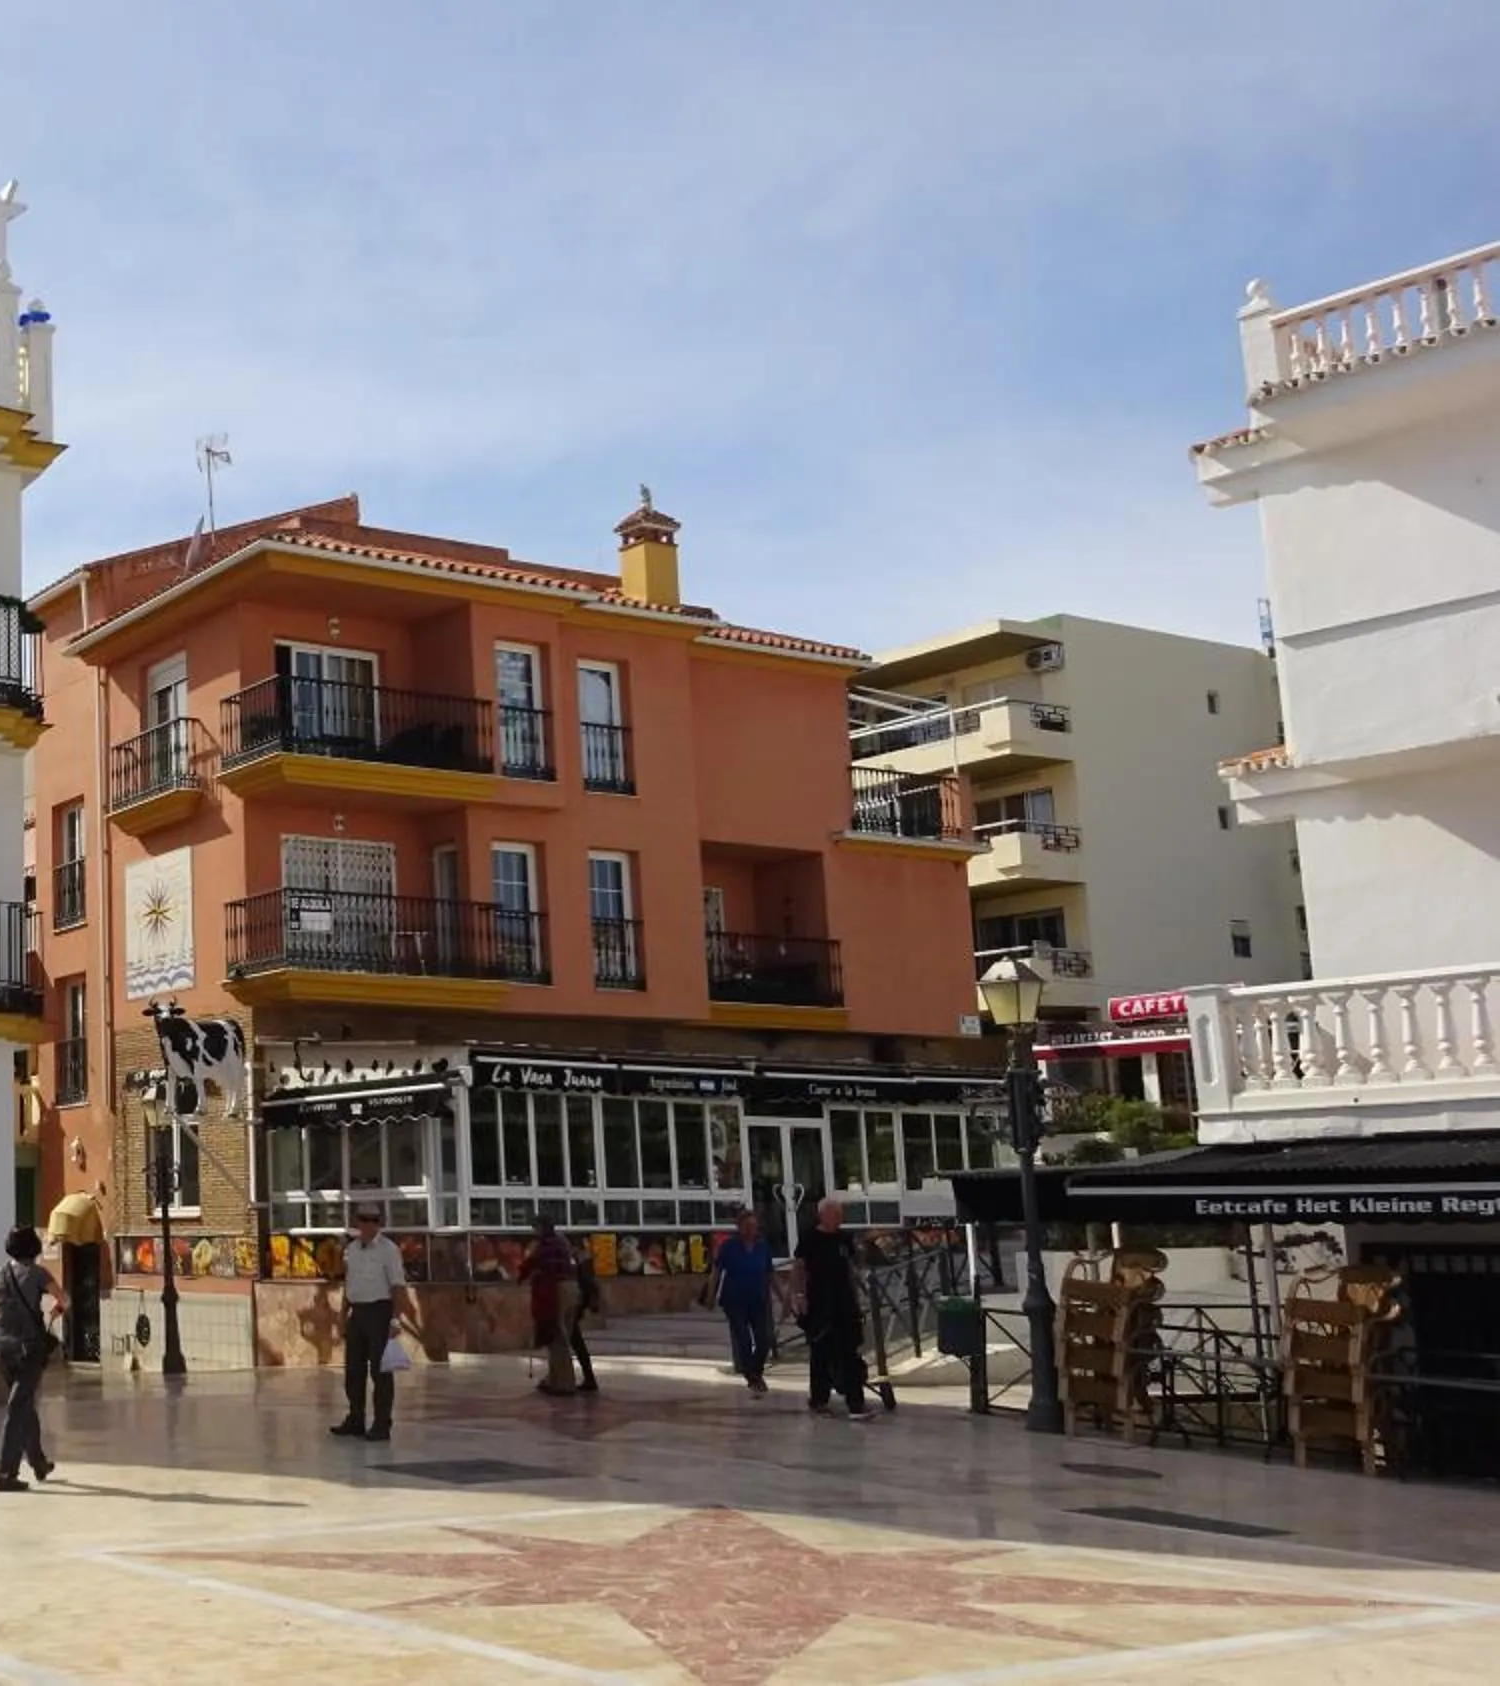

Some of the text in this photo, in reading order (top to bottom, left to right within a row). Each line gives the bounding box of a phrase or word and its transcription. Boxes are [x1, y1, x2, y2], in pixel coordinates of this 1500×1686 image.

[491, 1063, 603, 1089] La Vaca Juana
[1195, 1199, 1288, 1214] Eetcafe
[1296, 1199, 1341, 1213] Het
[1350, 1197, 1433, 1213] Kleine
